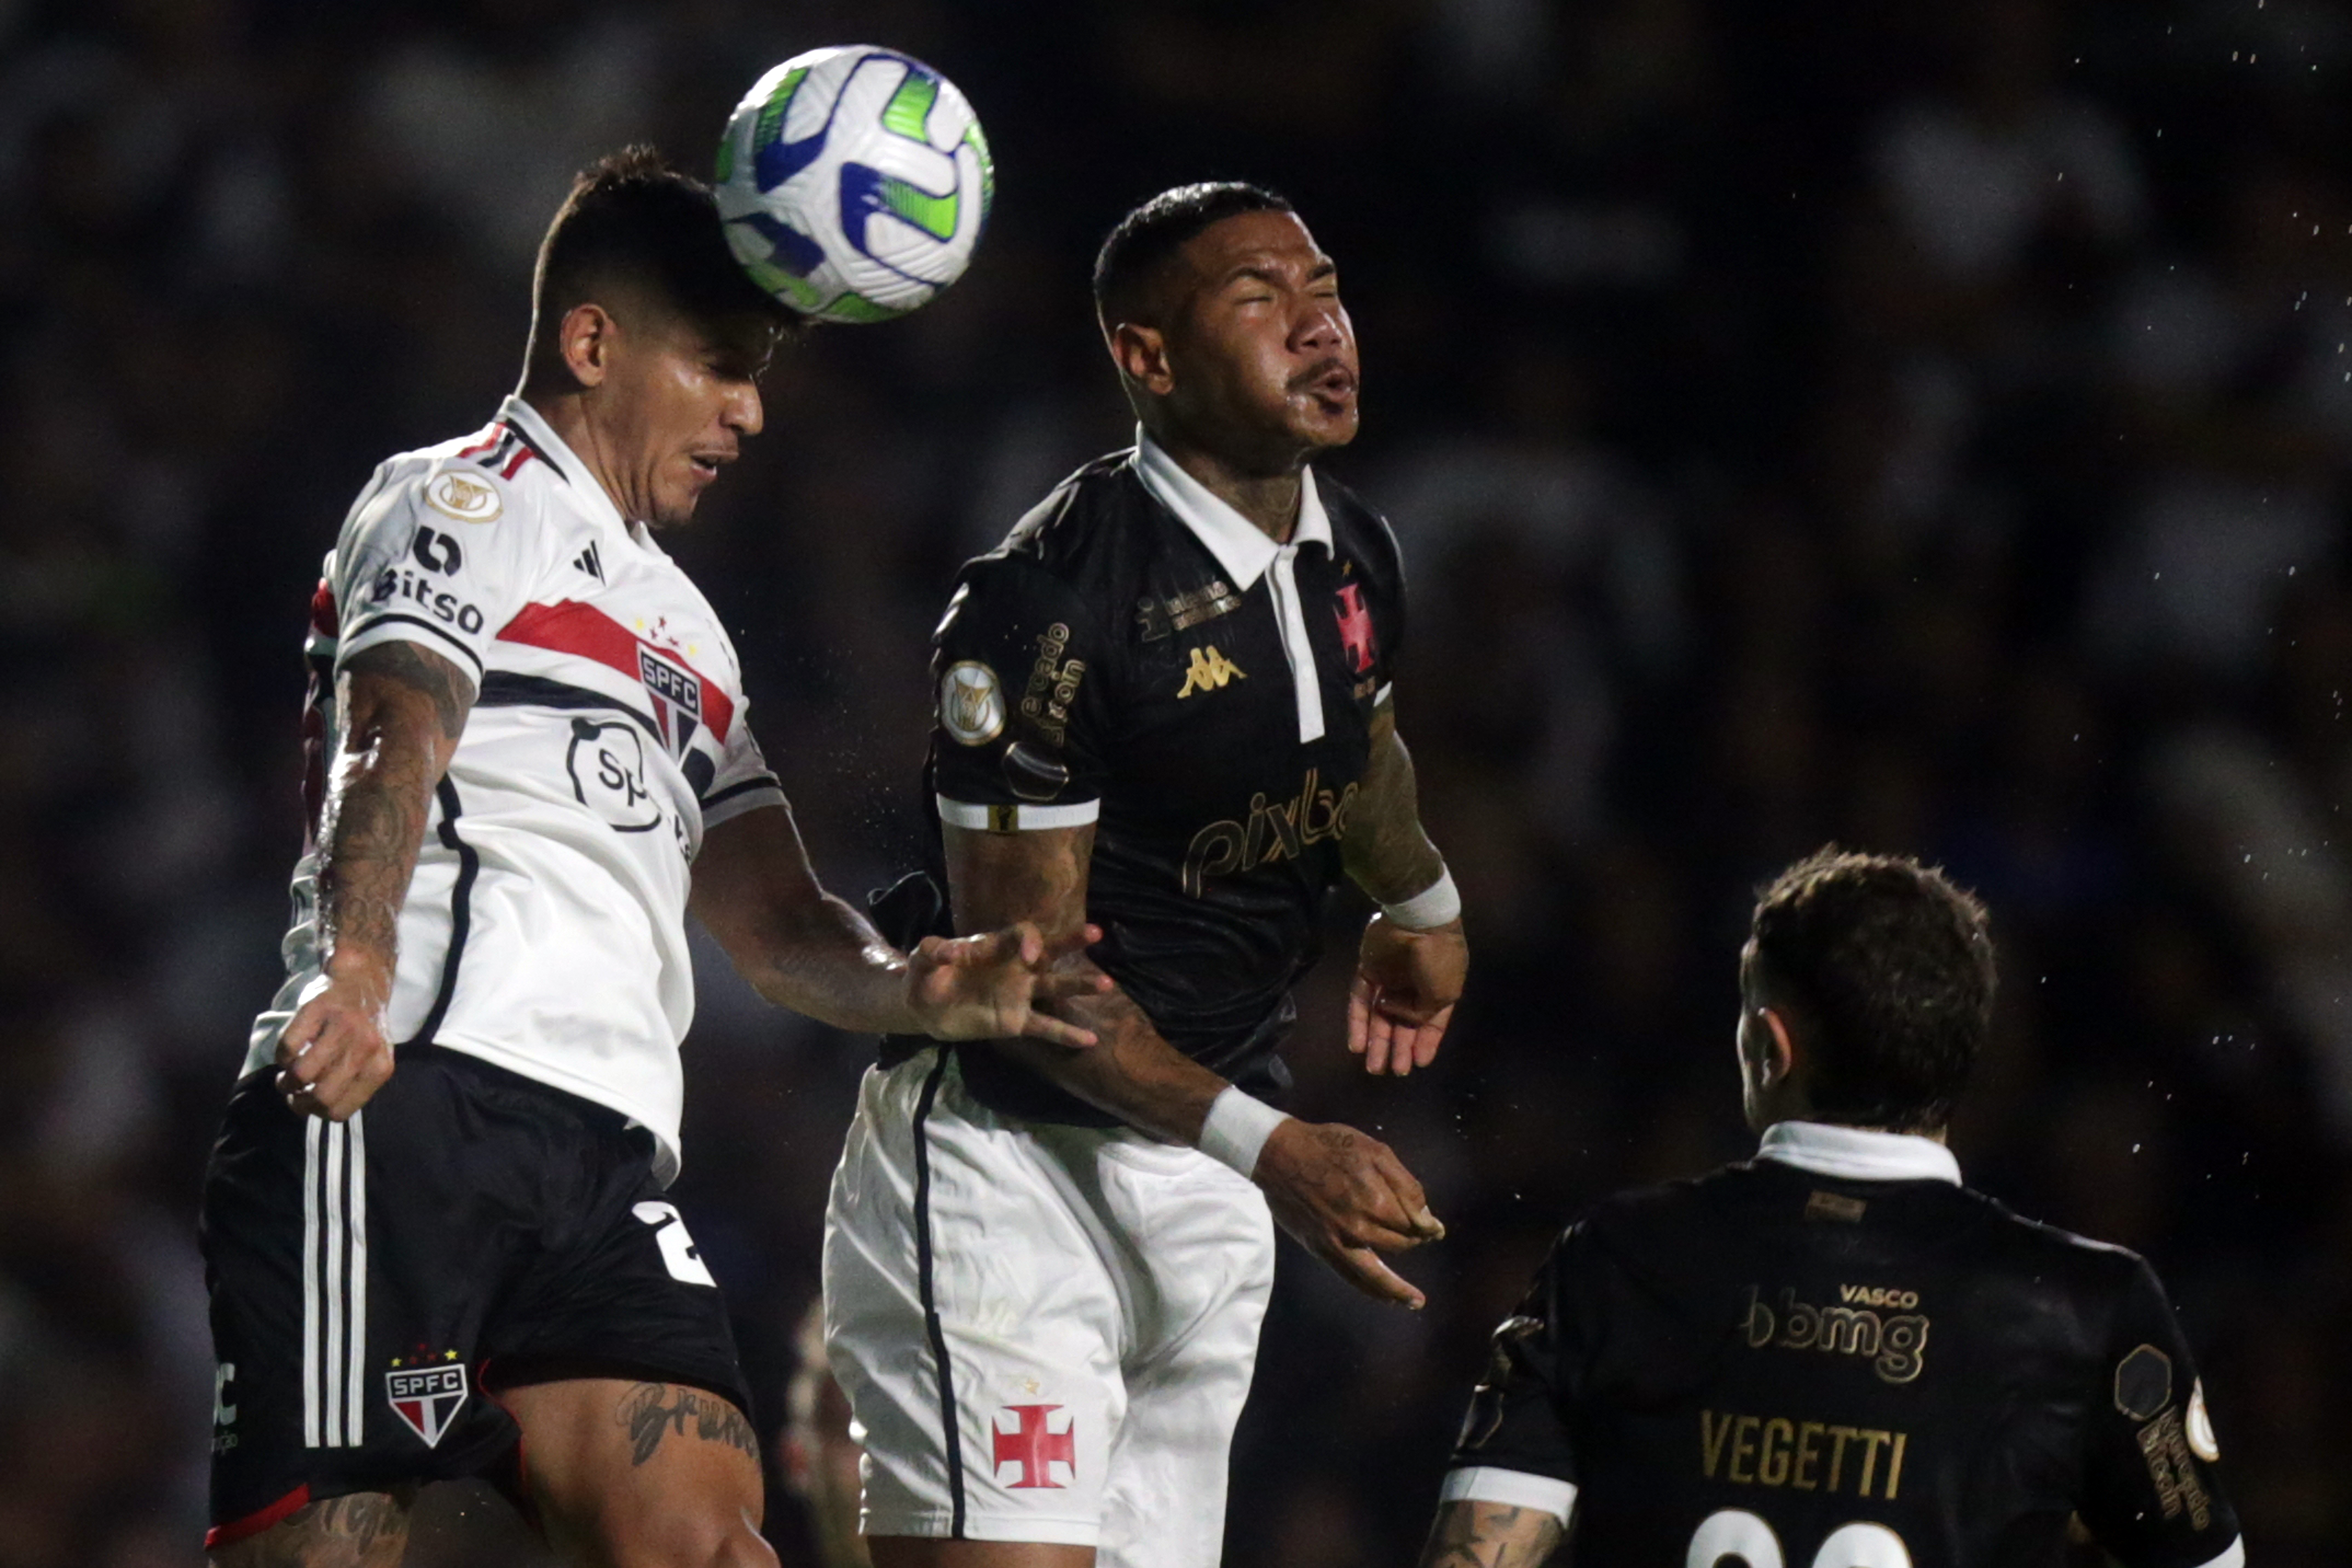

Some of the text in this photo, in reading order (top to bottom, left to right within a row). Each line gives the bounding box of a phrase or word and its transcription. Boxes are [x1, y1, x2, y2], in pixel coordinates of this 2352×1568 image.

[371, 568, 484, 634] Bitso
[642, 659, 697, 710] SPFC
[1840, 1283, 1919, 1309] VASCO
[393, 1372, 458, 1396] SPFC
[1701, 1409, 1908, 1499] VEGETTI
